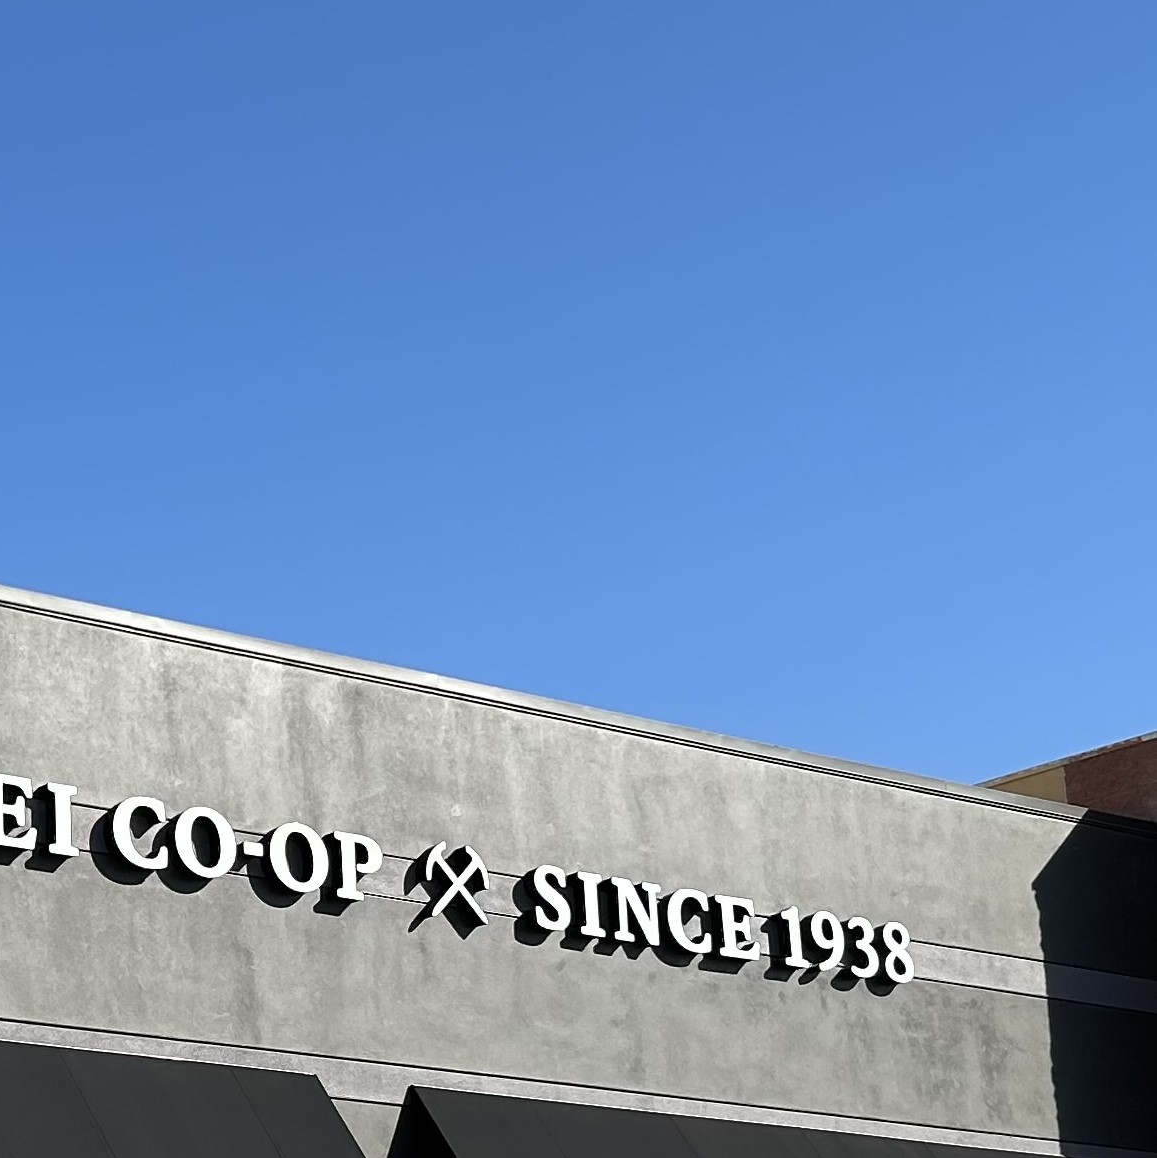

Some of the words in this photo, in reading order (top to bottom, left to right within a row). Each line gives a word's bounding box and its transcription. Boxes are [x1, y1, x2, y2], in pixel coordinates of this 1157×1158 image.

[112, 796, 383, 901] CO-OP
[533, 865, 759, 960] SINCE
[784, 905, 914, 984] 1938
